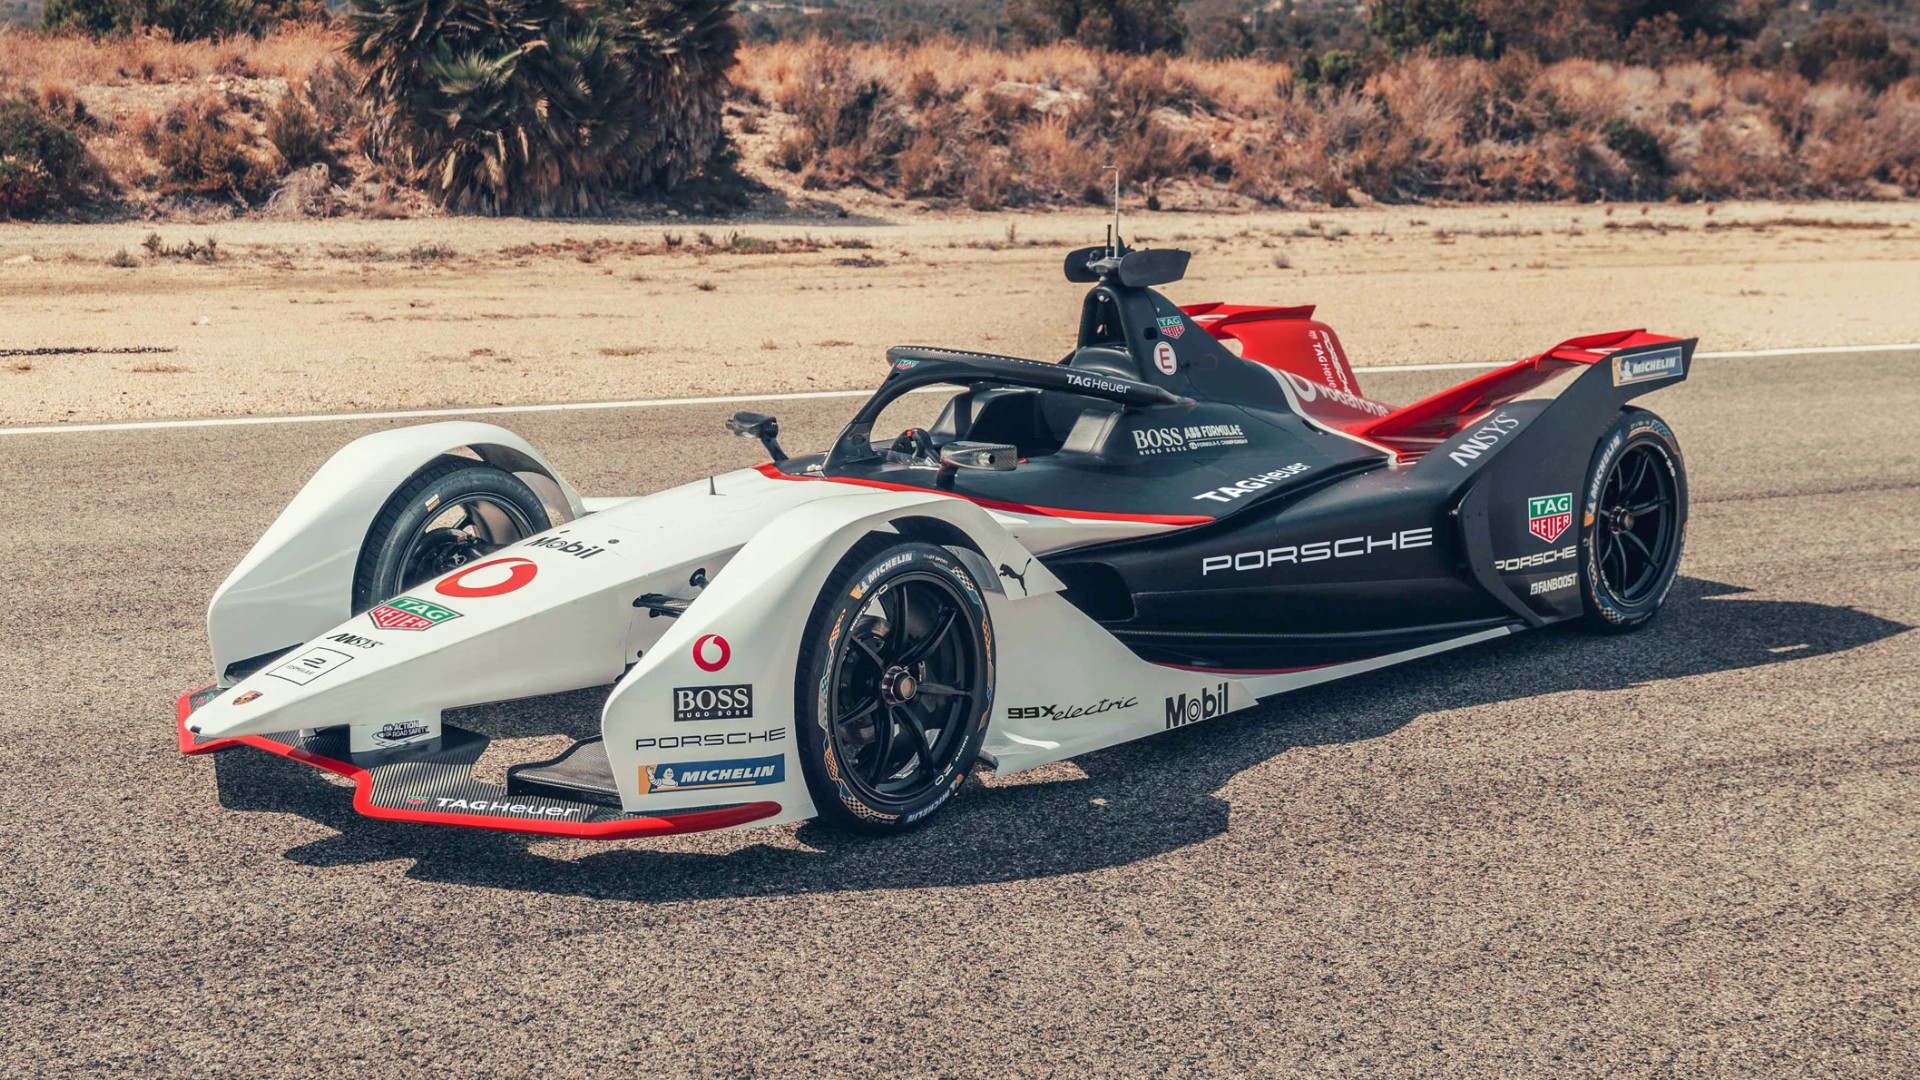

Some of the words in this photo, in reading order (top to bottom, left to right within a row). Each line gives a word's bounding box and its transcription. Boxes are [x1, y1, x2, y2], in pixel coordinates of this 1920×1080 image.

[1160, 318, 1180, 326] TAG
[1163, 325, 1184, 337] HEUER
[1159, 348, 1172, 369] E
[1633, 357, 1676, 374] MICHELIN
[1313, 382, 1388, 416] vodafone
[1132, 427, 1184, 449] BOSS
[1184, 426, 1201, 439] ABB
[1448, 414, 1519, 467] ANSYS
[1139, 447, 1162, 456] HUGO
[1591, 436, 1620, 499] MICHELIN
[1533, 497, 1568, 515] TAG
[1532, 515, 1569, 539] HEUER
[524, 537, 605, 559] Mobil
[1203, 527, 1432, 576] PORSCHE
[1495, 545, 1576, 571] PORSCHE
[867, 553, 913, 582] MICHELIN
[1538, 573, 1578, 594] FANBOOST
[377, 606, 431, 629] HEUER
[399, 600, 448, 622] TAG
[677, 688, 749, 711] BOSS
[1008, 704, 1057, 719] 99X
[1052, 696, 1138, 720] electric
[1166, 682, 1228, 729] Mobil
[393, 729, 408, 737] ROAD
[394, 721, 419, 730] ACTION
[636, 727, 786, 750] PORSCHE
[681, 765, 775, 783] MICHELIN
